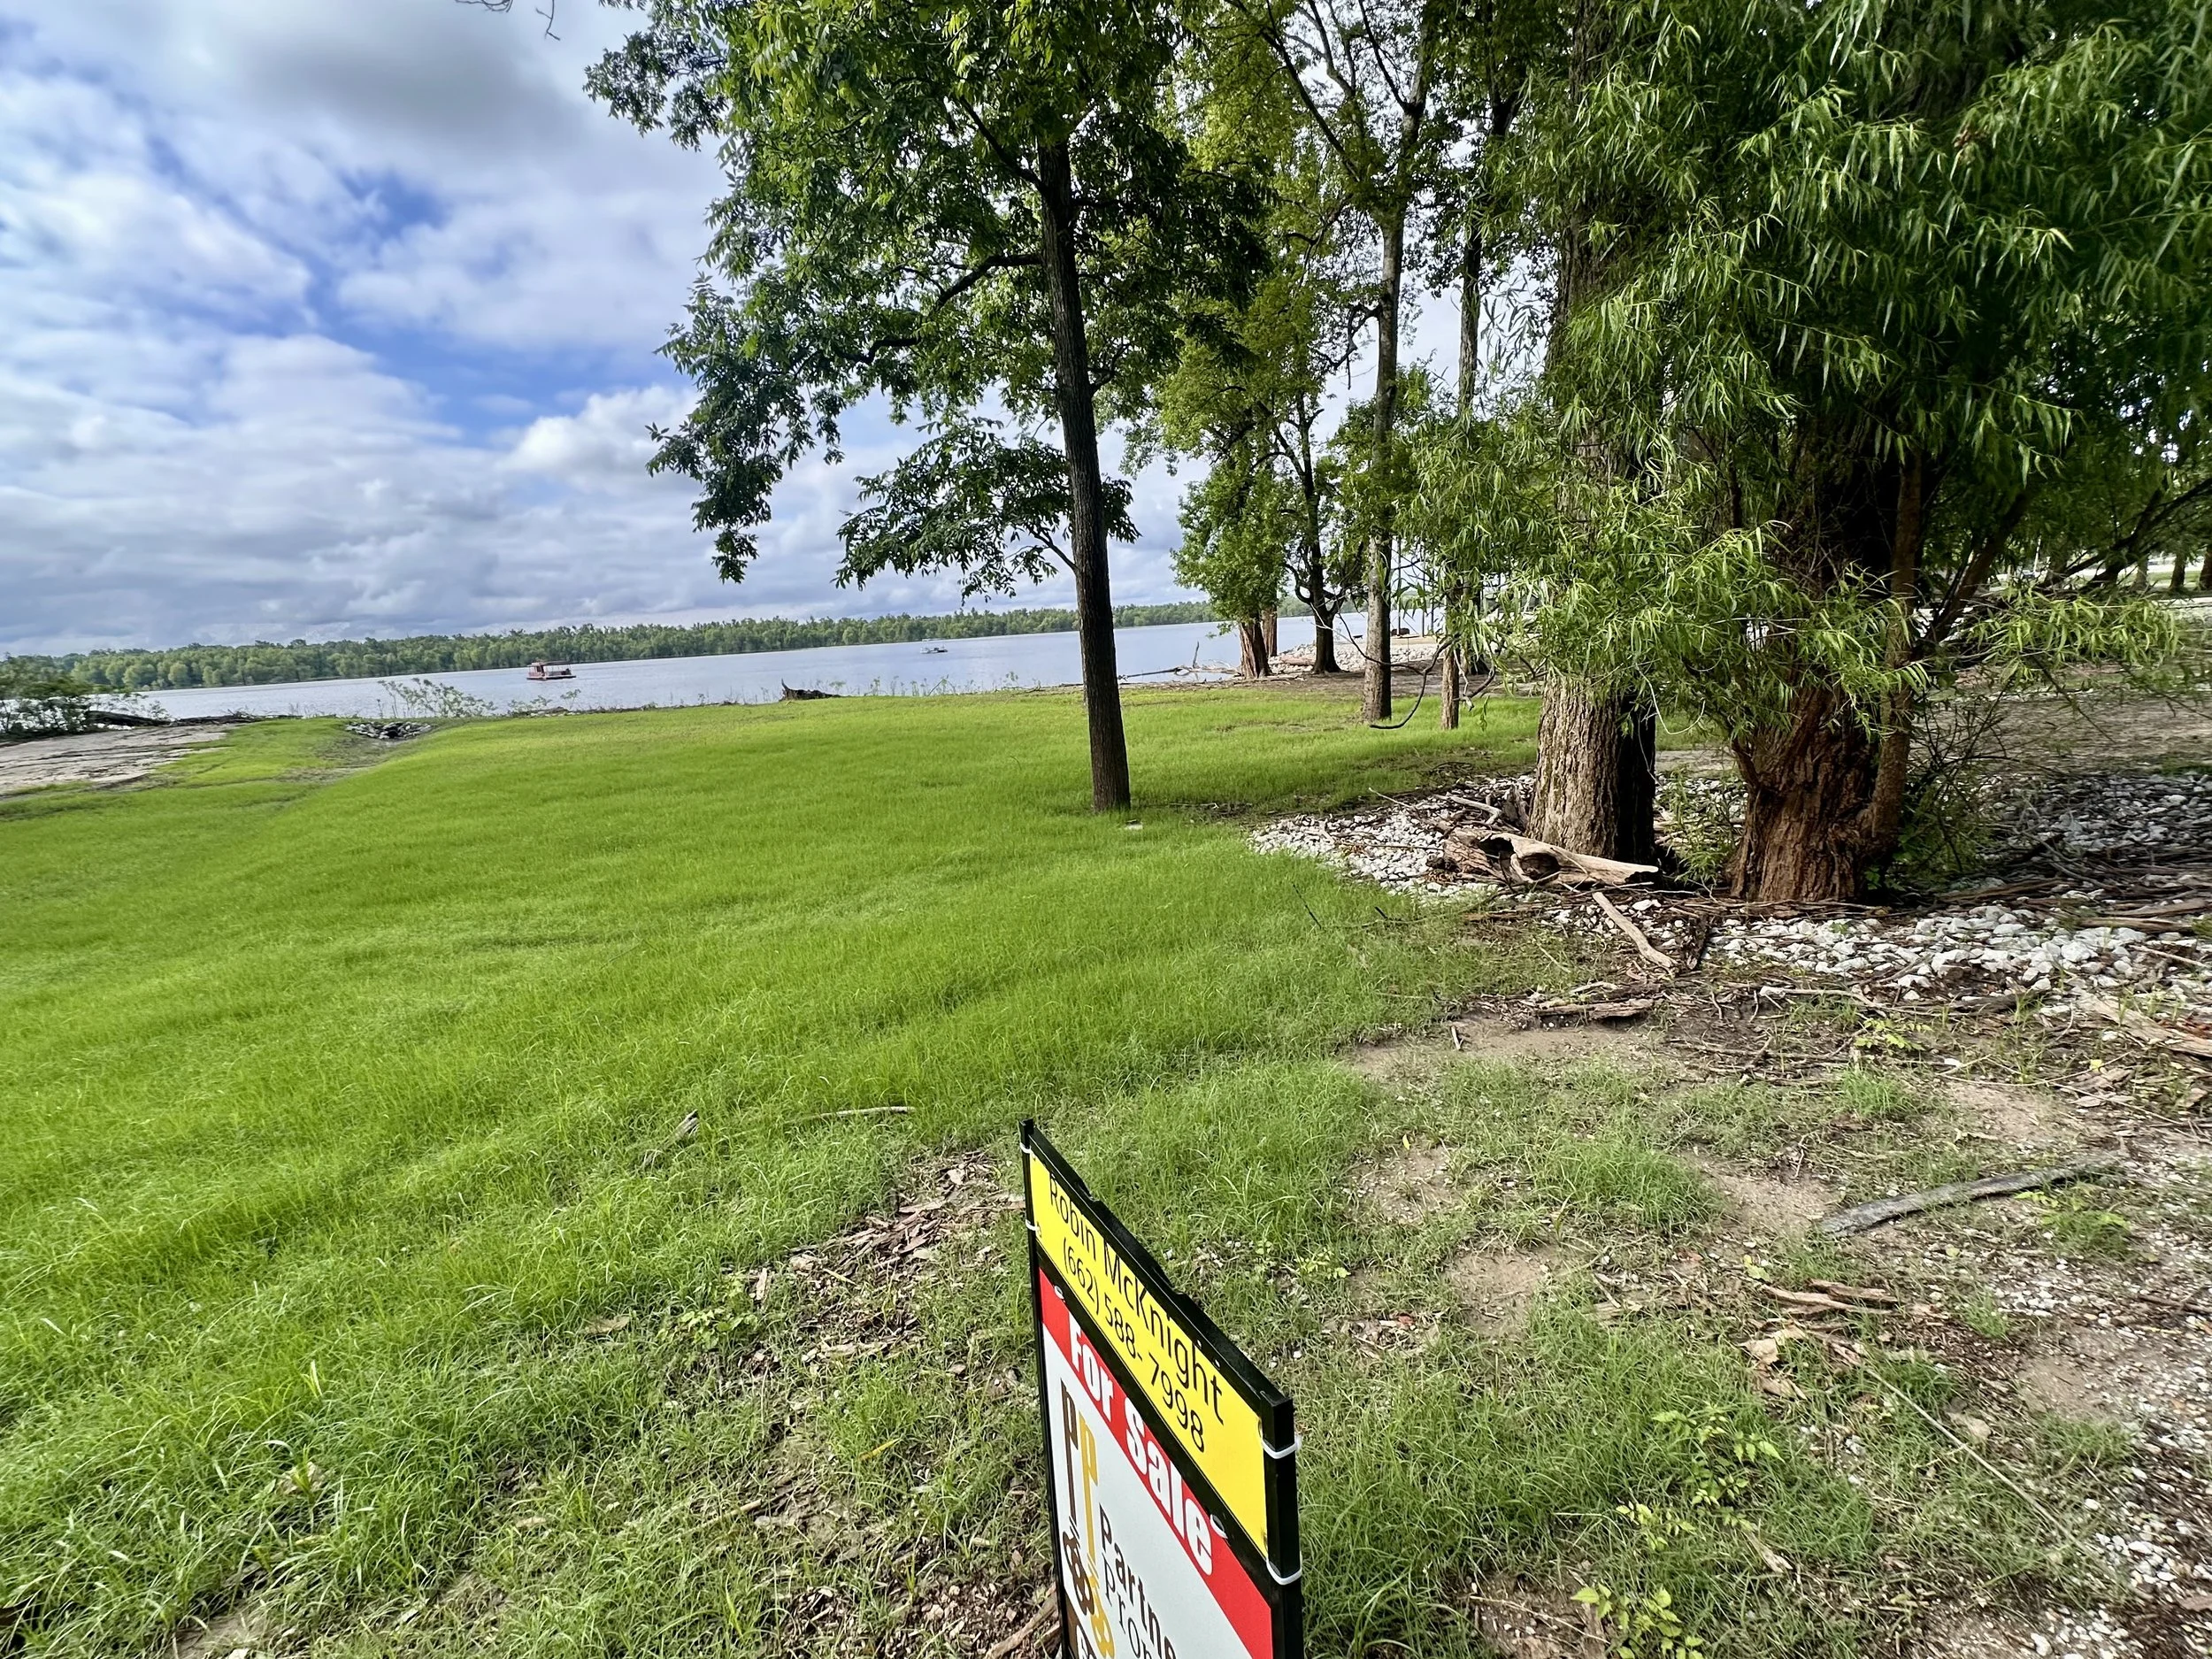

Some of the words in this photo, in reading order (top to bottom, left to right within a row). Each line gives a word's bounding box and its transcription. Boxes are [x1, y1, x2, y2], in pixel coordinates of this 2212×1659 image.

[1049, 1173, 1096, 1262] Robin
[1103, 1238, 1225, 1426] McKnight
[1063, 1237, 1100, 1316] (662)
[1068, 1311, 1114, 1423] For
[1124, 1396, 1213, 1576] Sale
